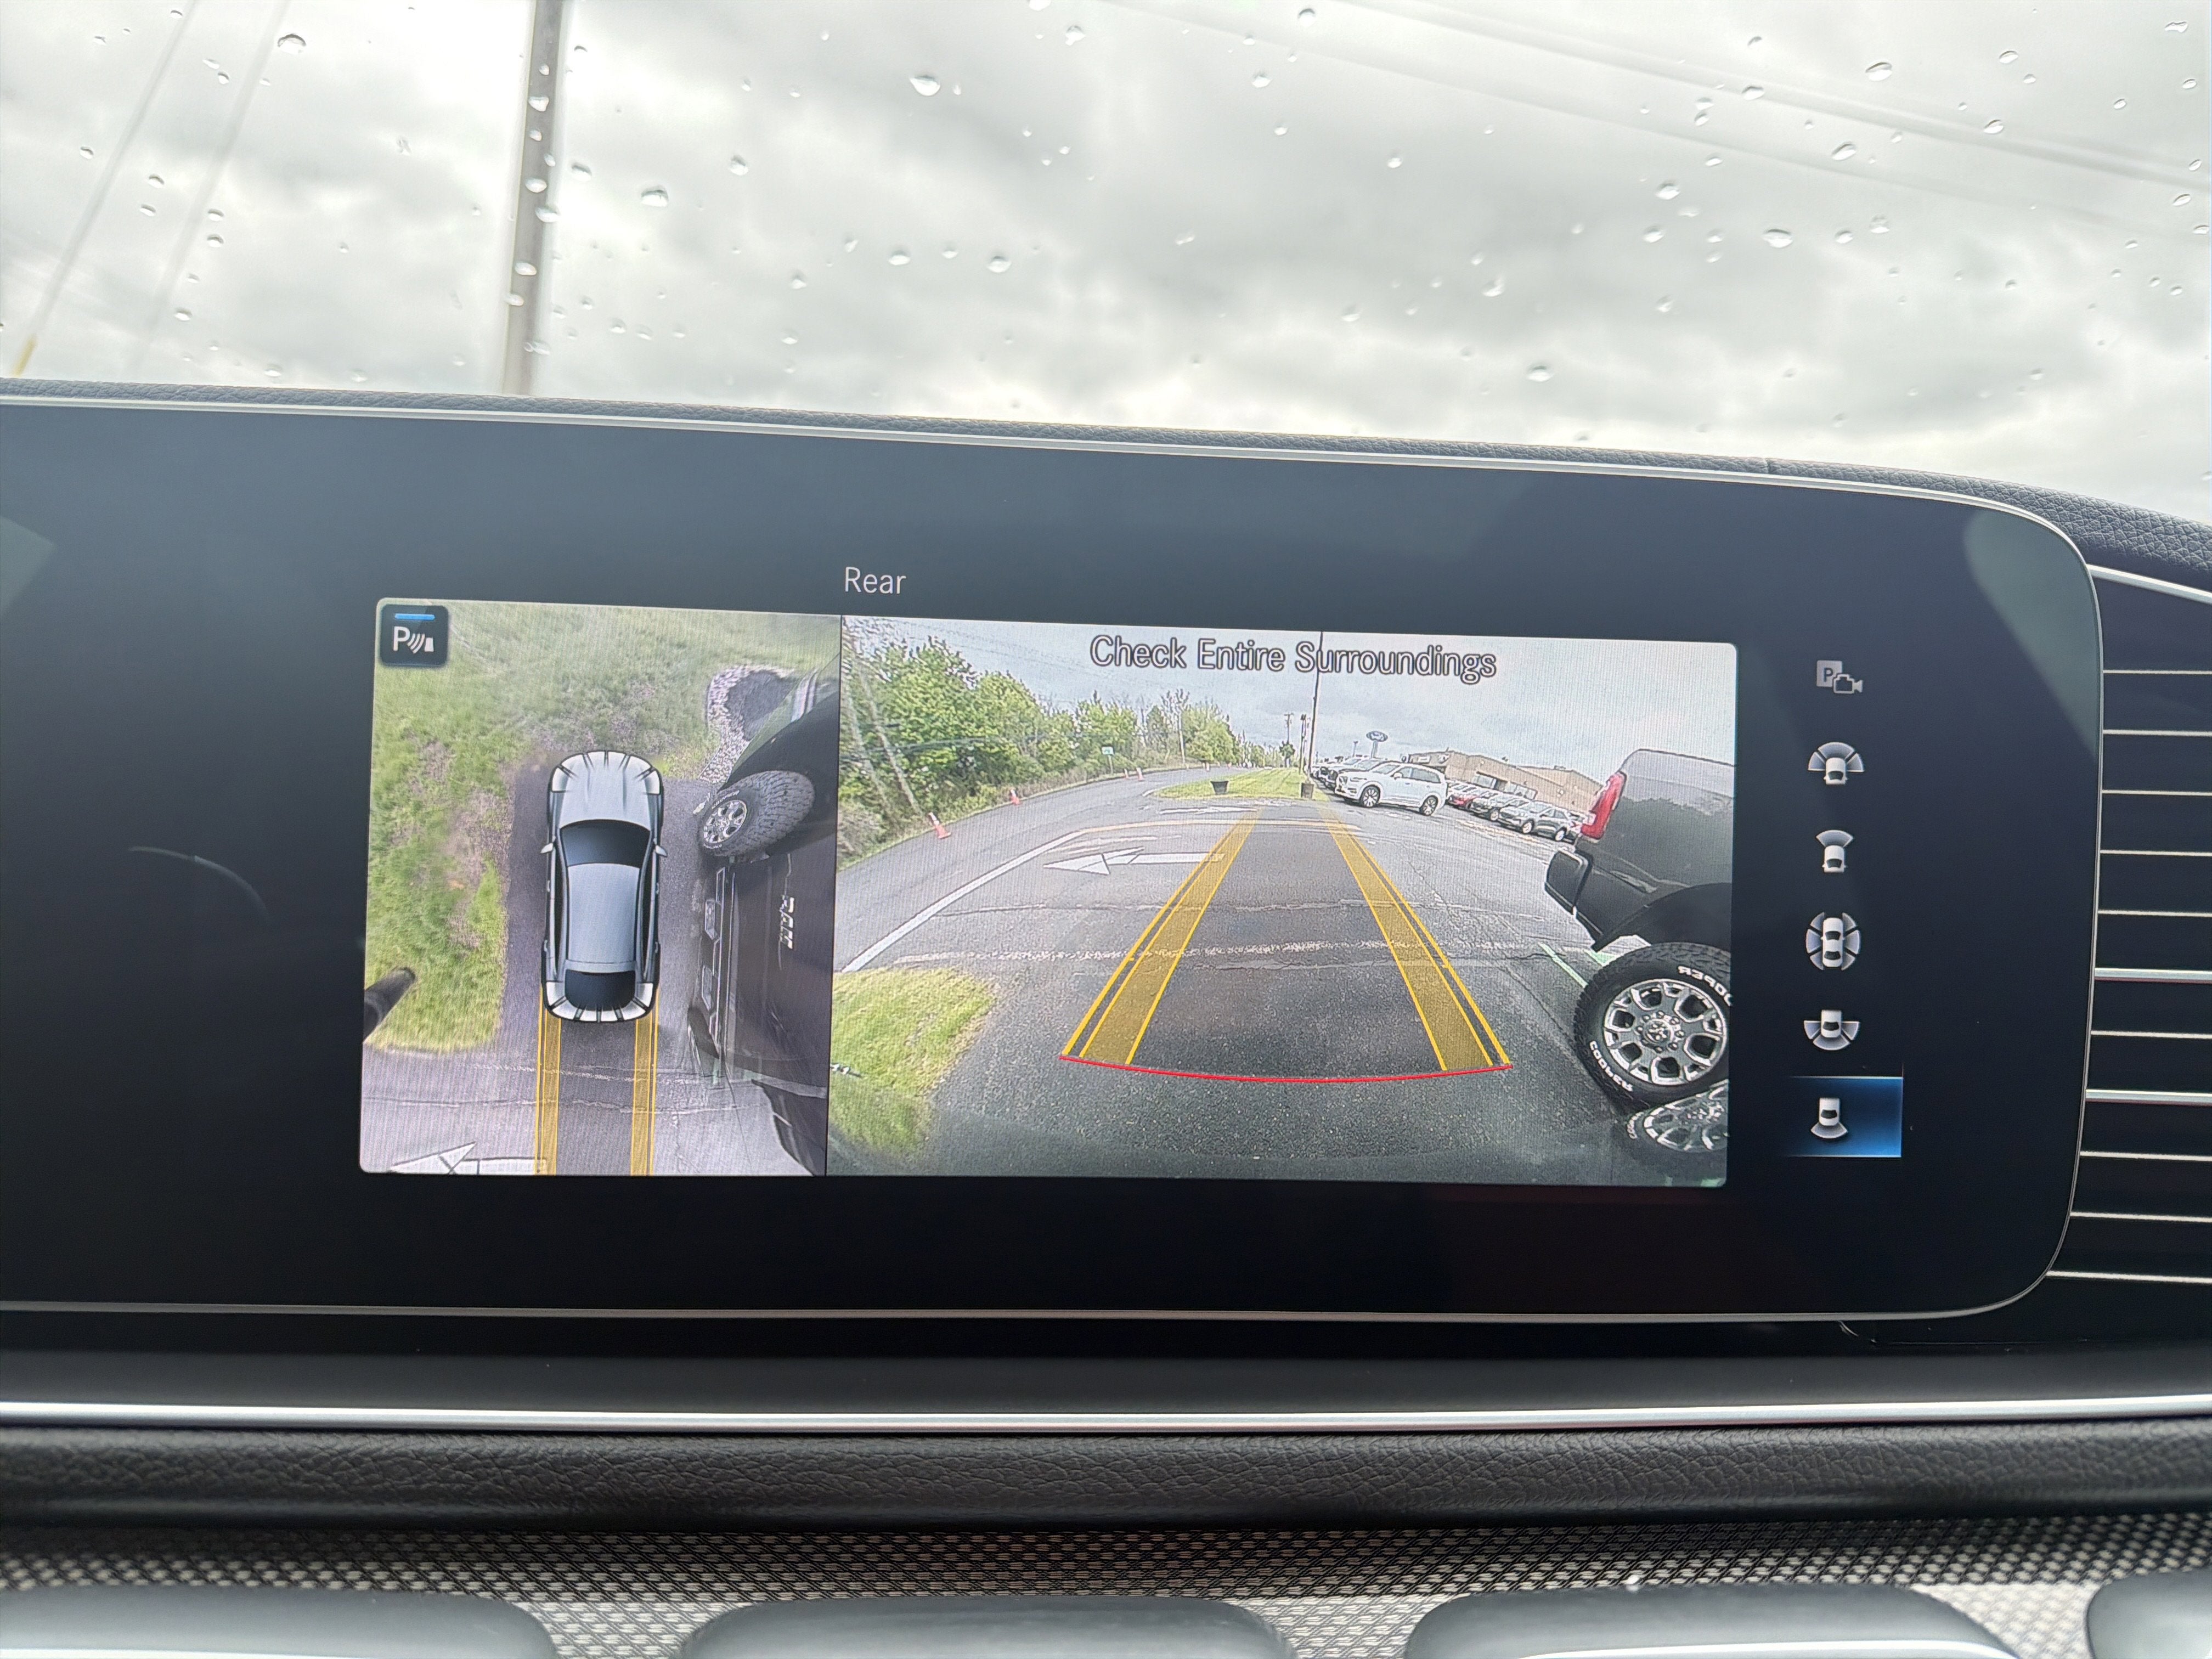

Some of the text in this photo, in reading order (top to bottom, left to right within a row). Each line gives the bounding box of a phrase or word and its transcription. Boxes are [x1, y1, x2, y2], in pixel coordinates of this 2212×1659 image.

[845, 566, 907, 594] Rear
[1090, 634, 1497, 685] Check Entire Surroundings
